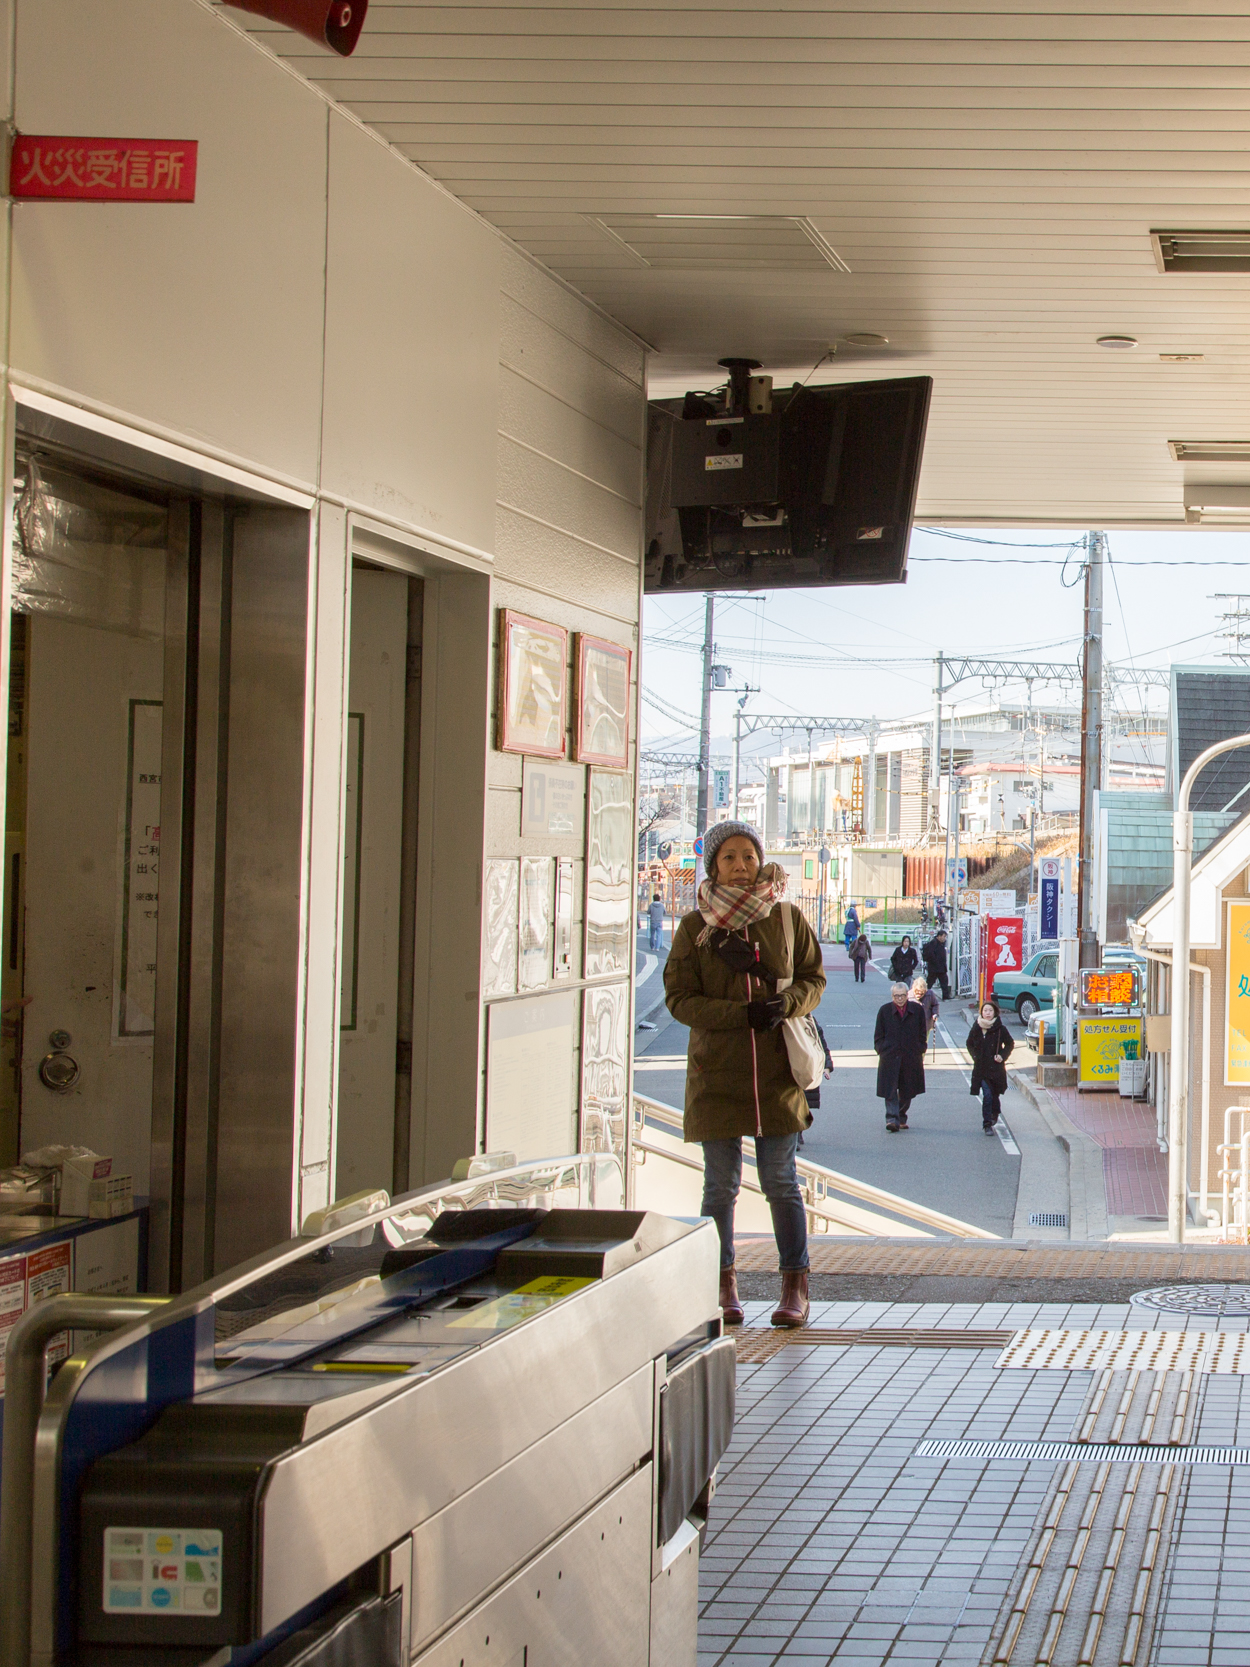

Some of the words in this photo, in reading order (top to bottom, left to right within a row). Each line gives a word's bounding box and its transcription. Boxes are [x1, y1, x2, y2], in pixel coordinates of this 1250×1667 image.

[20, 148, 185, 189] 火災受信所
[1046, 883, 1054, 929] 阪神タクシー
[997, 925, 1017, 934] Coca-Cola
[1088, 973, 1133, 989] お薬
[1088, 989, 1132, 1003] 相談
[1084, 1024, 1137, 1034] 処方せん受付
[1232, 1029, 1246, 1037] TEL
[1231, 1044, 1247, 1052] FAX
